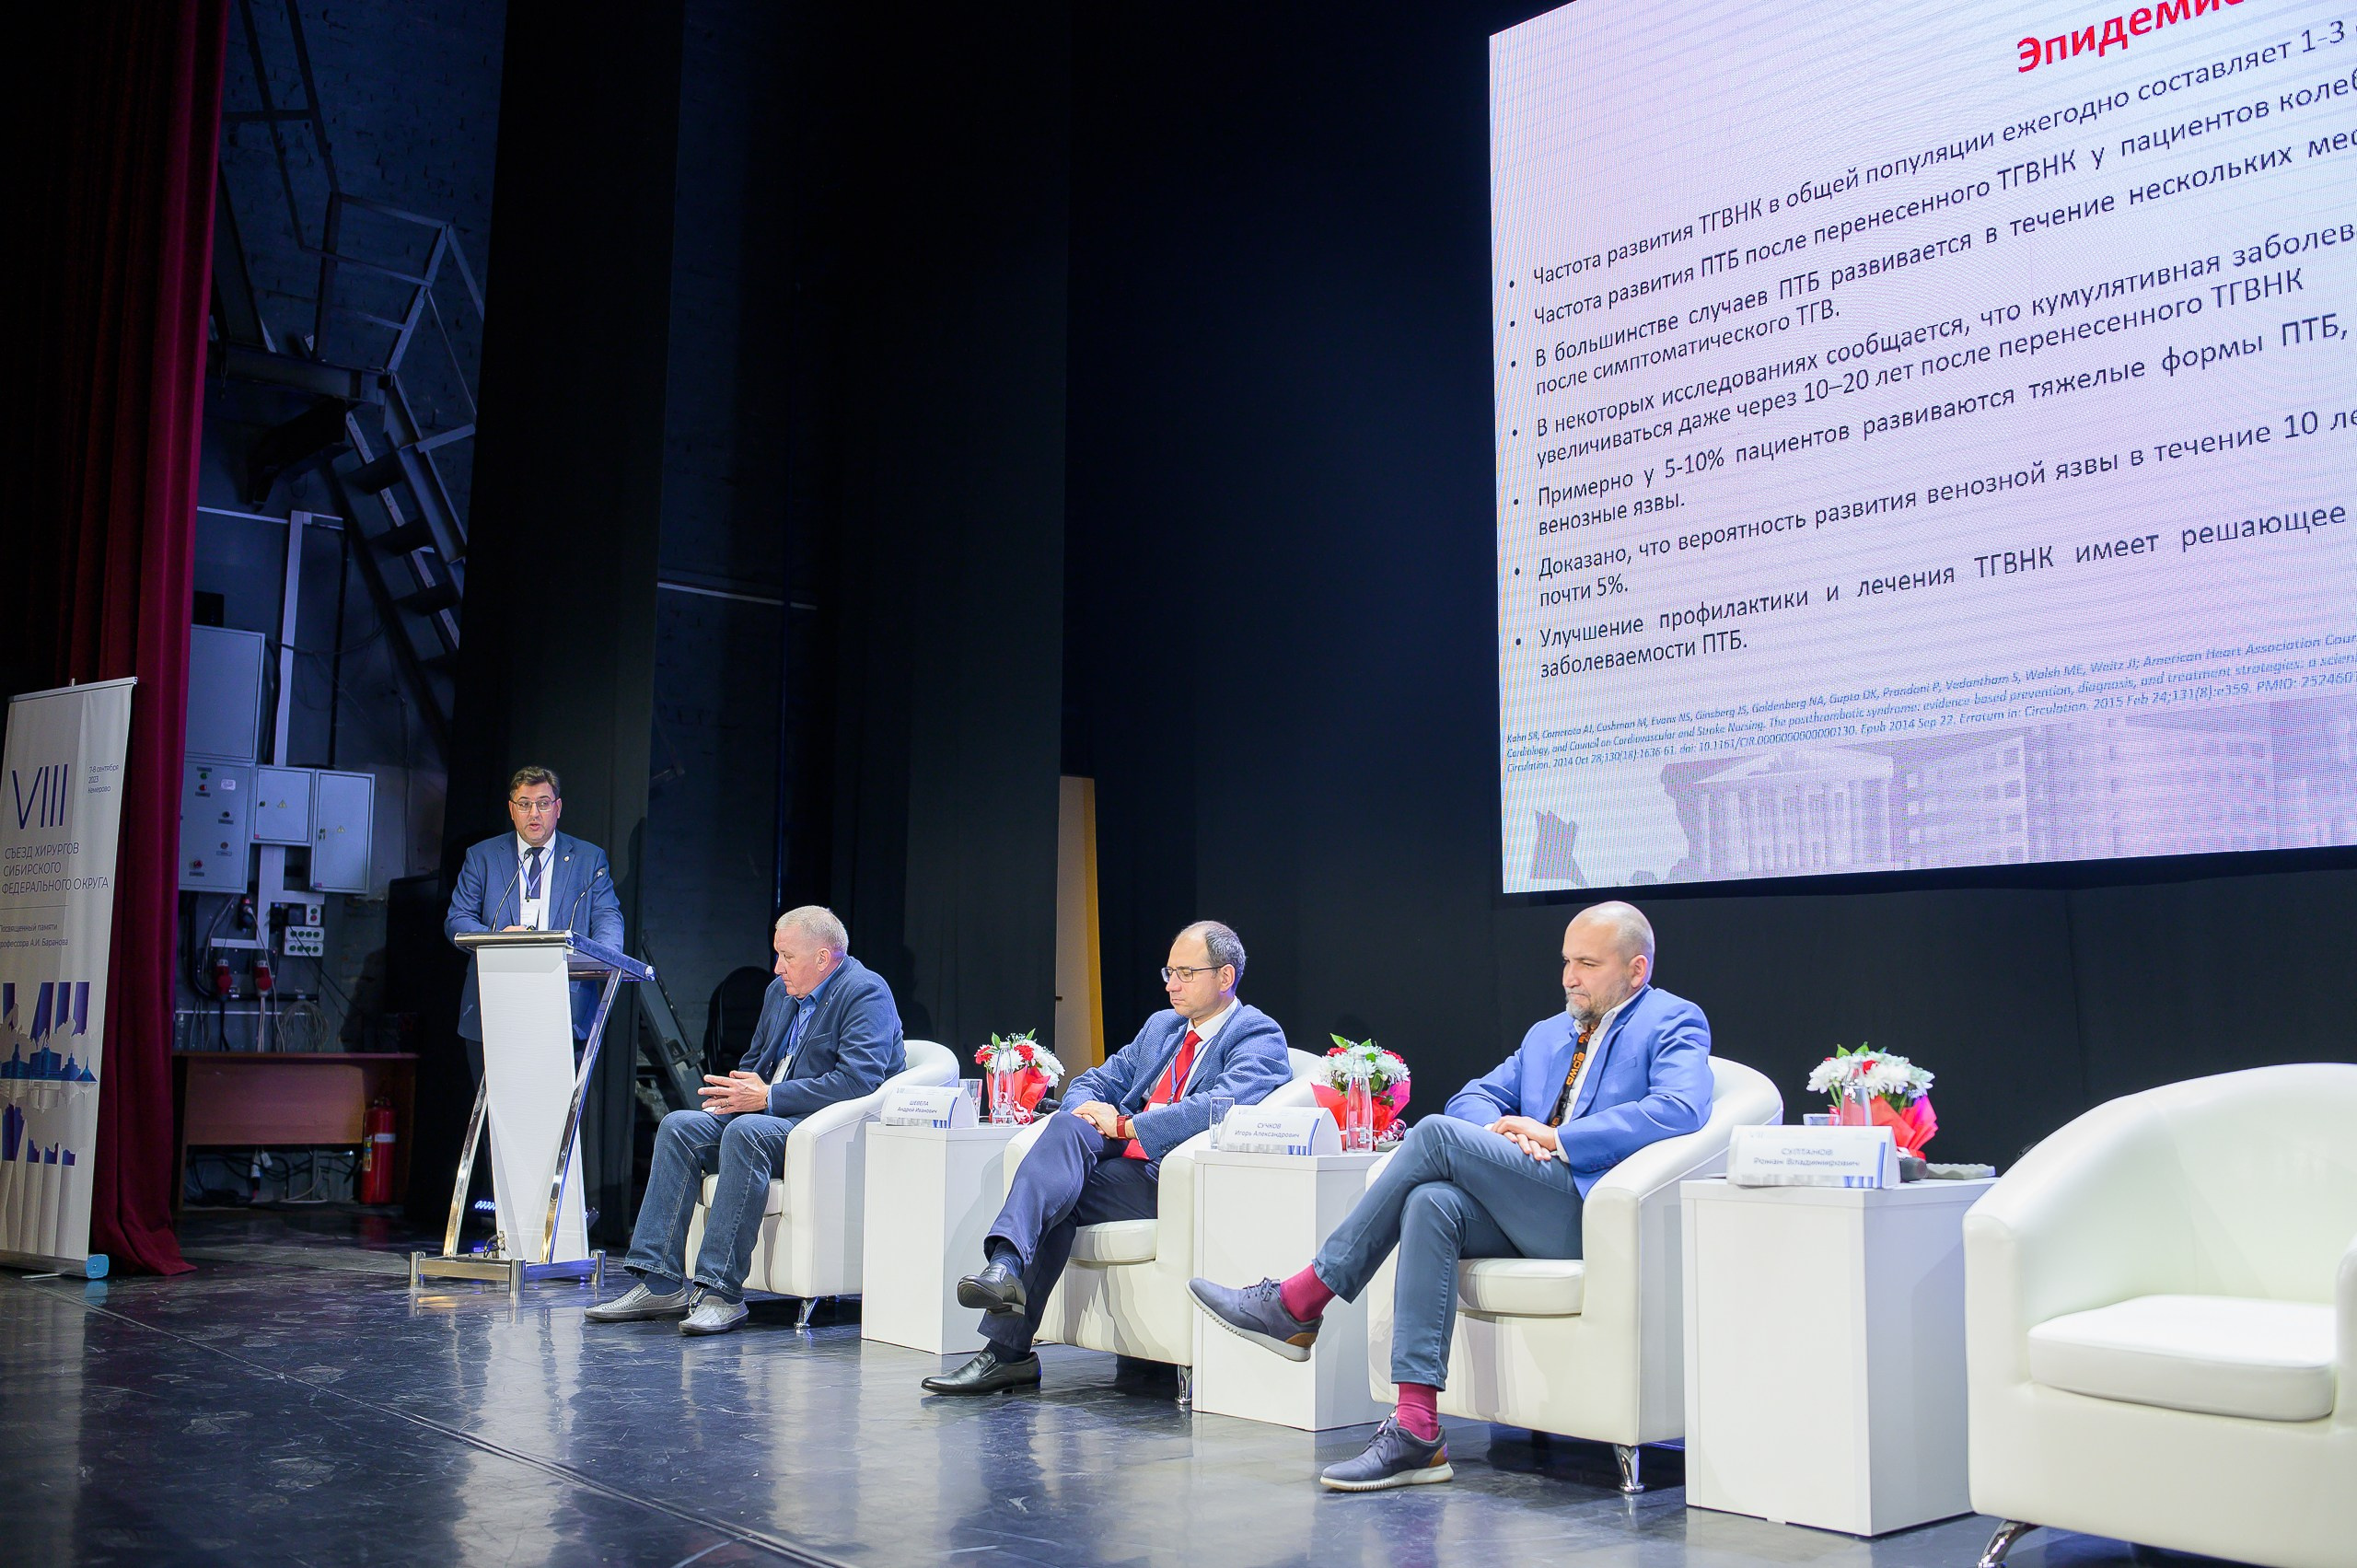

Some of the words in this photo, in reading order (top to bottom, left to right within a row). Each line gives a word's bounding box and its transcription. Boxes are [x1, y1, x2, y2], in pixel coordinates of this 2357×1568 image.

[2016, 0, 2247, 74] Эпидеми
[1533, 254, 1601, 285] Частота
[1607, 225, 1694, 268] развития
[1699, 197, 1763, 236] ТГВНК
[1770, 198, 1781, 214] в
[1786, 167, 1859, 208] общей
[1866, 132, 1994, 184] популяции
[2003, 91, 2130, 142] ежегодно
[2138, 41, 2291, 101] составляет
[2301, 20, 2346, 53] 1-3
[1534, 295, 1602, 325] Частота
[1608, 266, 1694, 310] развития
[1701, 248, 1739, 277] ПТБ
[1746, 234, 1807, 265] после
[1814, 180, 1991, 245] перенесенного
[1997, 148, 2076, 191] ТГВНК
[2090, 146, 2105, 170] у
[2121, 101, 2270, 157] пациентов
[1536, 348, 1547, 367] В
[1554, 315, 1678, 362] большинстве
[1689, 290, 1768, 325] случаев
[1780, 270, 1819, 300] ПТБ
[1831, 233, 1971, 291] развивается
[1986, 226, 1998, 244] в
[2009, 195, 2115, 237] течение
[2129, 145, 2293, 205] нескольких
[1537, 418, 1548, 438] В
[1555, 394, 1655, 434] некоторых
[1662, 354, 1818, 407] исследованиях
[1827, 318, 1969, 366] сообщается,
[1980, 304, 2021, 327] что
[2032, 255, 2220, 317] кумулятивная
[2233, 224, 2357, 267] заболев
[1537, 370, 1587, 396] после
[1593, 316, 1790, 380] симптоматического
[1795, 298, 1840, 326] ТГВ.
[1537, 421, 1673, 470] увеличиваться
[1678, 408, 1731, 437] даже
[1736, 391, 1797, 417] через
[1875, 364, 1914, 387] лет
[1922, 346, 1991, 377] после
[1999, 297, 2202, 358] перенесенного
[2210, 267, 2305, 308] ТГВНК
[1538, 473, 1633, 509] Примерно
[1643, 468, 1655, 489] у
[1665, 447, 1724, 479] 5-10%
[1736, 424, 1851, 463] пациентов
[1864, 389, 2014, 442] развиваются
[2027, 361, 2145, 399] тяжелые
[2162, 335, 2263, 377] формы
[2282, 313, 2348, 346] ПТБ,
[1538, 548, 1631, 582] Доказано,
[1639, 540, 1671, 557] что
[1678, 514, 1806, 551] вероятность
[1815, 492, 1916, 529] развития
[1927, 459, 2046, 505] венозной
[2055, 454, 2118, 481] язвы
[2131, 449, 2144, 467] в
[2154, 426, 2271, 462] течение
[2284, 411, 2318, 439] 10
[1538, 504, 1627, 536] венозные
[1633, 493, 1685, 517] язвы.
[1539, 618, 1643, 649] Улучшение
[1659, 590, 1808, 632] профилактики
[1827, 585, 1839, 602] и
[1856, 567, 1955, 598] лечения
[1973, 545, 2054, 578] ТГВНК
[2076, 534, 2159, 563] имеет
[2182, 505, 2346, 553] решающее
[1539, 584, 1591, 608] почти
[1596, 573, 1629, 597] 5%.
[1540, 641, 1696, 679] заболеваемости
[1702, 629, 1747, 655] ПТБ.
[12, 763, 68, 830] VIII
[2, 878, 71, 895] ФЕДЕРАЛЬНОГО
[74, 877, 109, 890] ОКРУГА
[3, 862, 62, 877] СИБИРСКОГО
[5, 846, 33, 860] СЪЕЗД
[35, 842, 79, 857] ХИРУРГОВ
[1253, 1131, 1300, 1139] Александрович
